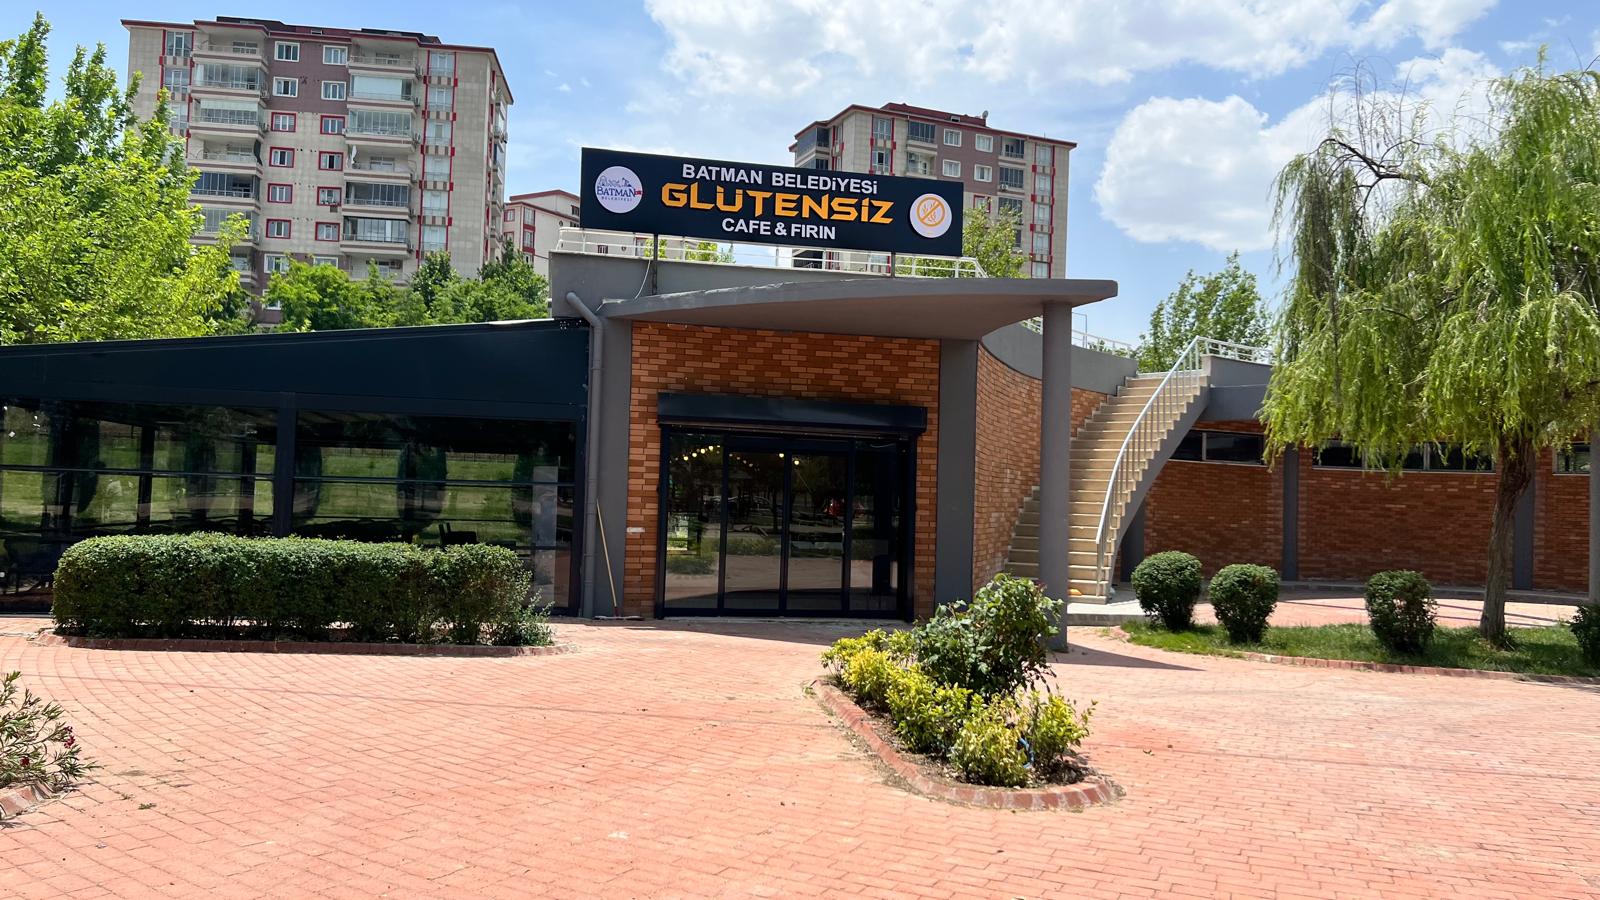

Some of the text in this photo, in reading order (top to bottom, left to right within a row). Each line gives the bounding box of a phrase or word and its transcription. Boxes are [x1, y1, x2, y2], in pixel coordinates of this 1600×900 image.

[682, 164, 763, 184] BATMAN
[596, 186, 636, 197] BATMAN
[721, 218, 836, 240] CAFE & FIRIN
